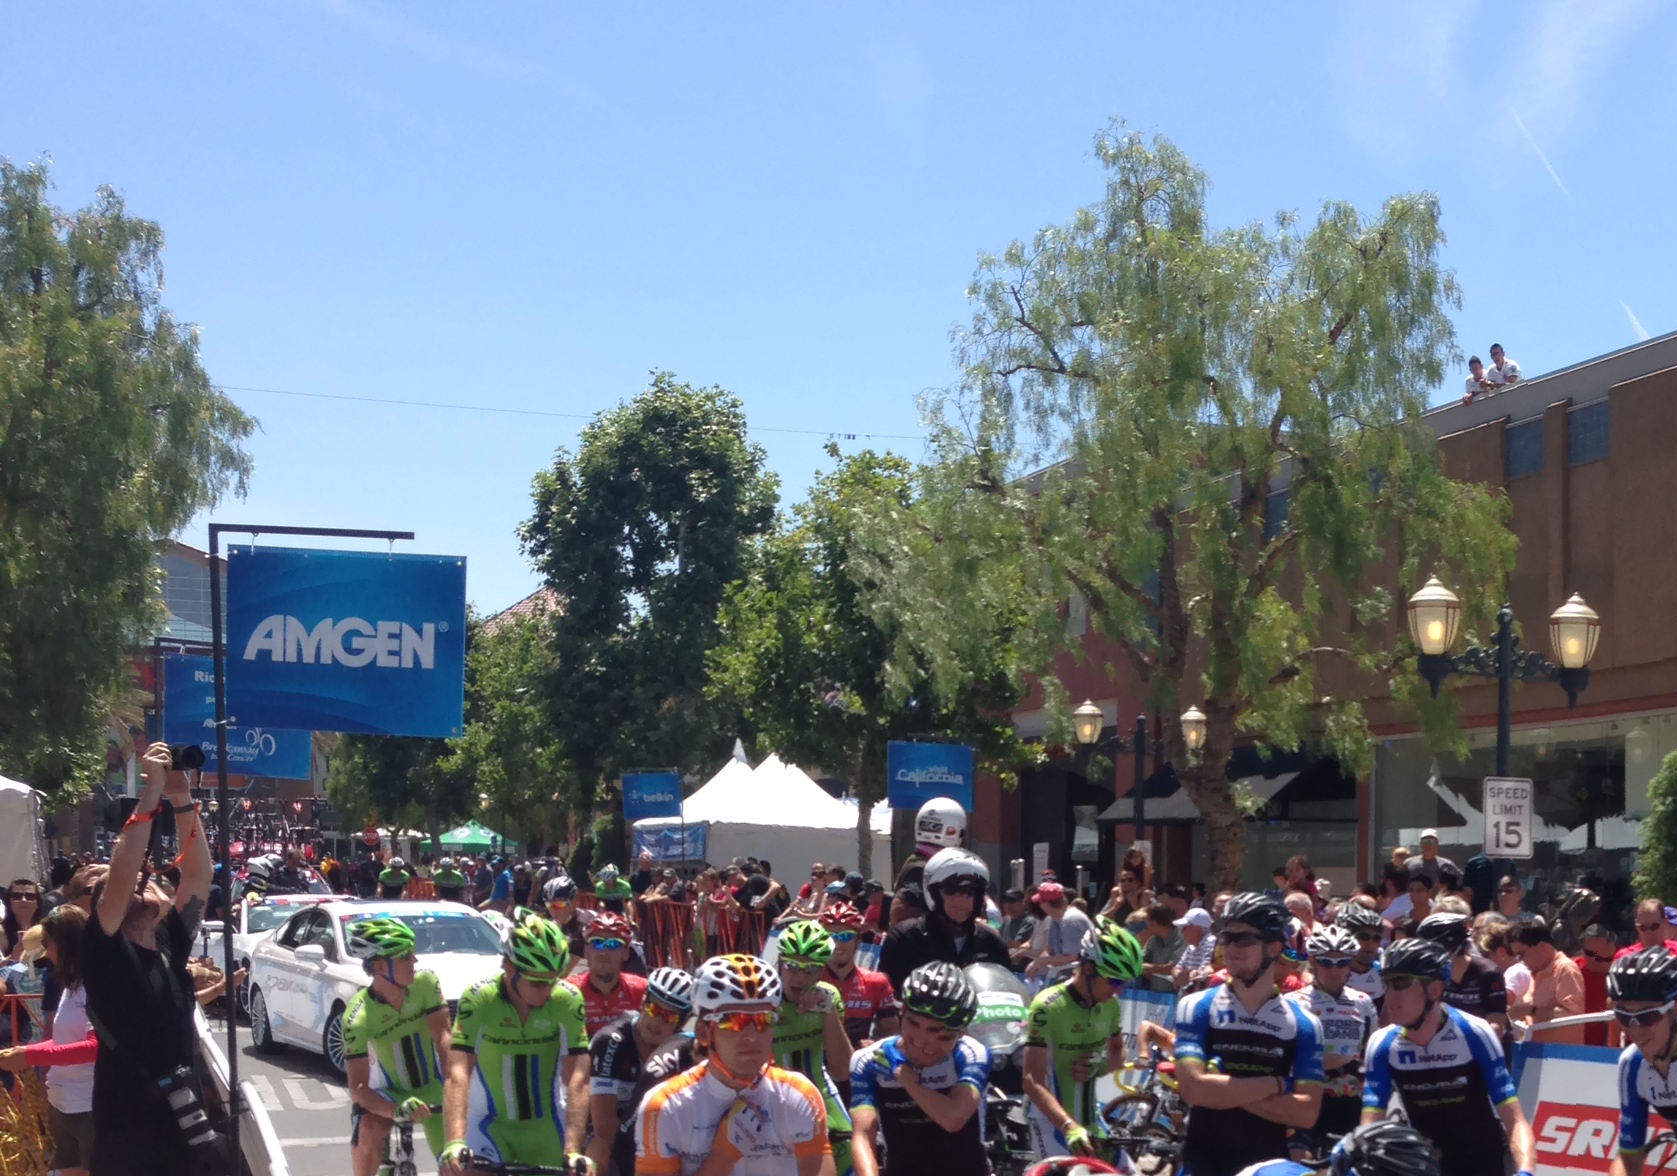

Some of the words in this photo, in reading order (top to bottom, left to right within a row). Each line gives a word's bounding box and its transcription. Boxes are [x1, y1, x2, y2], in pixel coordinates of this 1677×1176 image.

[243, 614, 435, 669] AMGEN
[1488, 787, 1529, 799] SPEED
[1493, 804, 1524, 815] LIMIT
[1493, 821, 1522, 849] 15
[976, 1006, 1021, 1020] Photo
[600, 1032, 621, 1078] latexco
[645, 1049, 680, 1078] sky
